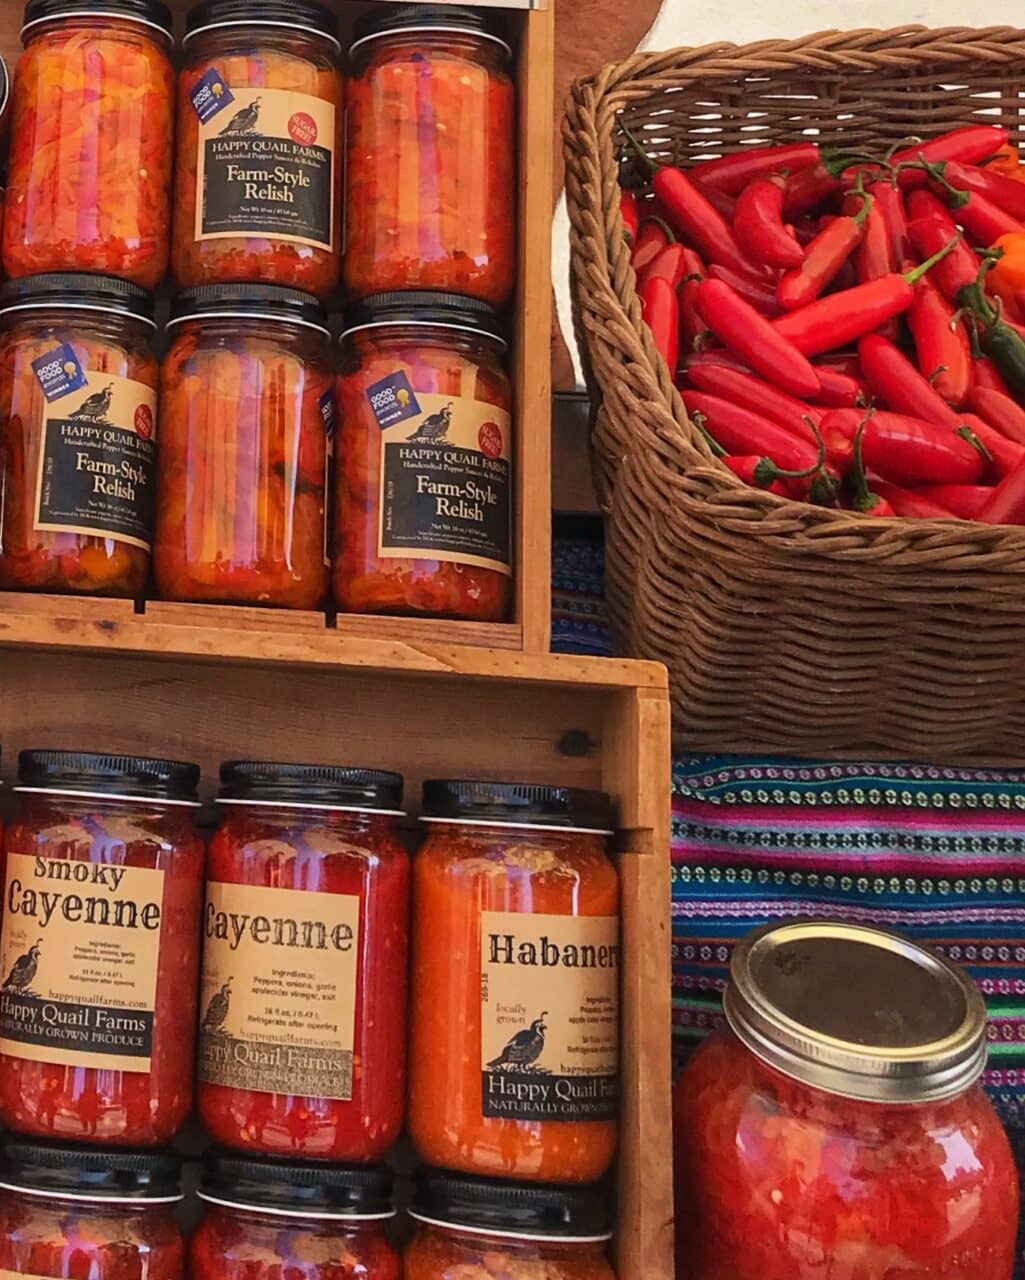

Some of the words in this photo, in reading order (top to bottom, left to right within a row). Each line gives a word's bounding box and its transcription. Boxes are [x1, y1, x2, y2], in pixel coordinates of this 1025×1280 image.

[212, 141, 250, 153] HAPPY
[252, 141, 290, 156] QUAIL
[227, 165, 311, 189] Farm-Style
[245, 183, 294, 203] Relish
[61, 425, 102, 441] HAPPY
[103, 429, 136, 448] QUAIL
[76, 452, 147, 485] Farm-Style
[399, 448, 441, 461] HAPPY
[443, 449, 480, 466] QUAIL
[93, 475, 136, 501] Relish
[416, 475, 497, 505] Farm-Style
[436, 497, 483, 521] Relish
[34, 856, 127, 891] Smoky
[8, 880, 161, 930] Cayenne
[205, 902, 353, 951] Cayenne
[488, 934, 618, 968] Habaner
[0, 995, 38, 1023] Happy
[41, 1004, 89, 1026] Quail
[96, 1010, 146, 1032] Farms
[496, 1003, 526, 1016] locally
[496, 1016, 526, 1025] grown
[46, 1027, 88, 1041] GROWN
[92, 1032, 144, 1047] PRODUCE
[234, 1044, 281, 1065] Quail
[287, 1049, 342, 1070] Farms
[488, 1075, 550, 1100] Happy
[555, 1079, 597, 1101] Quail
[489, 1100, 558, 1113] NATURALLY
